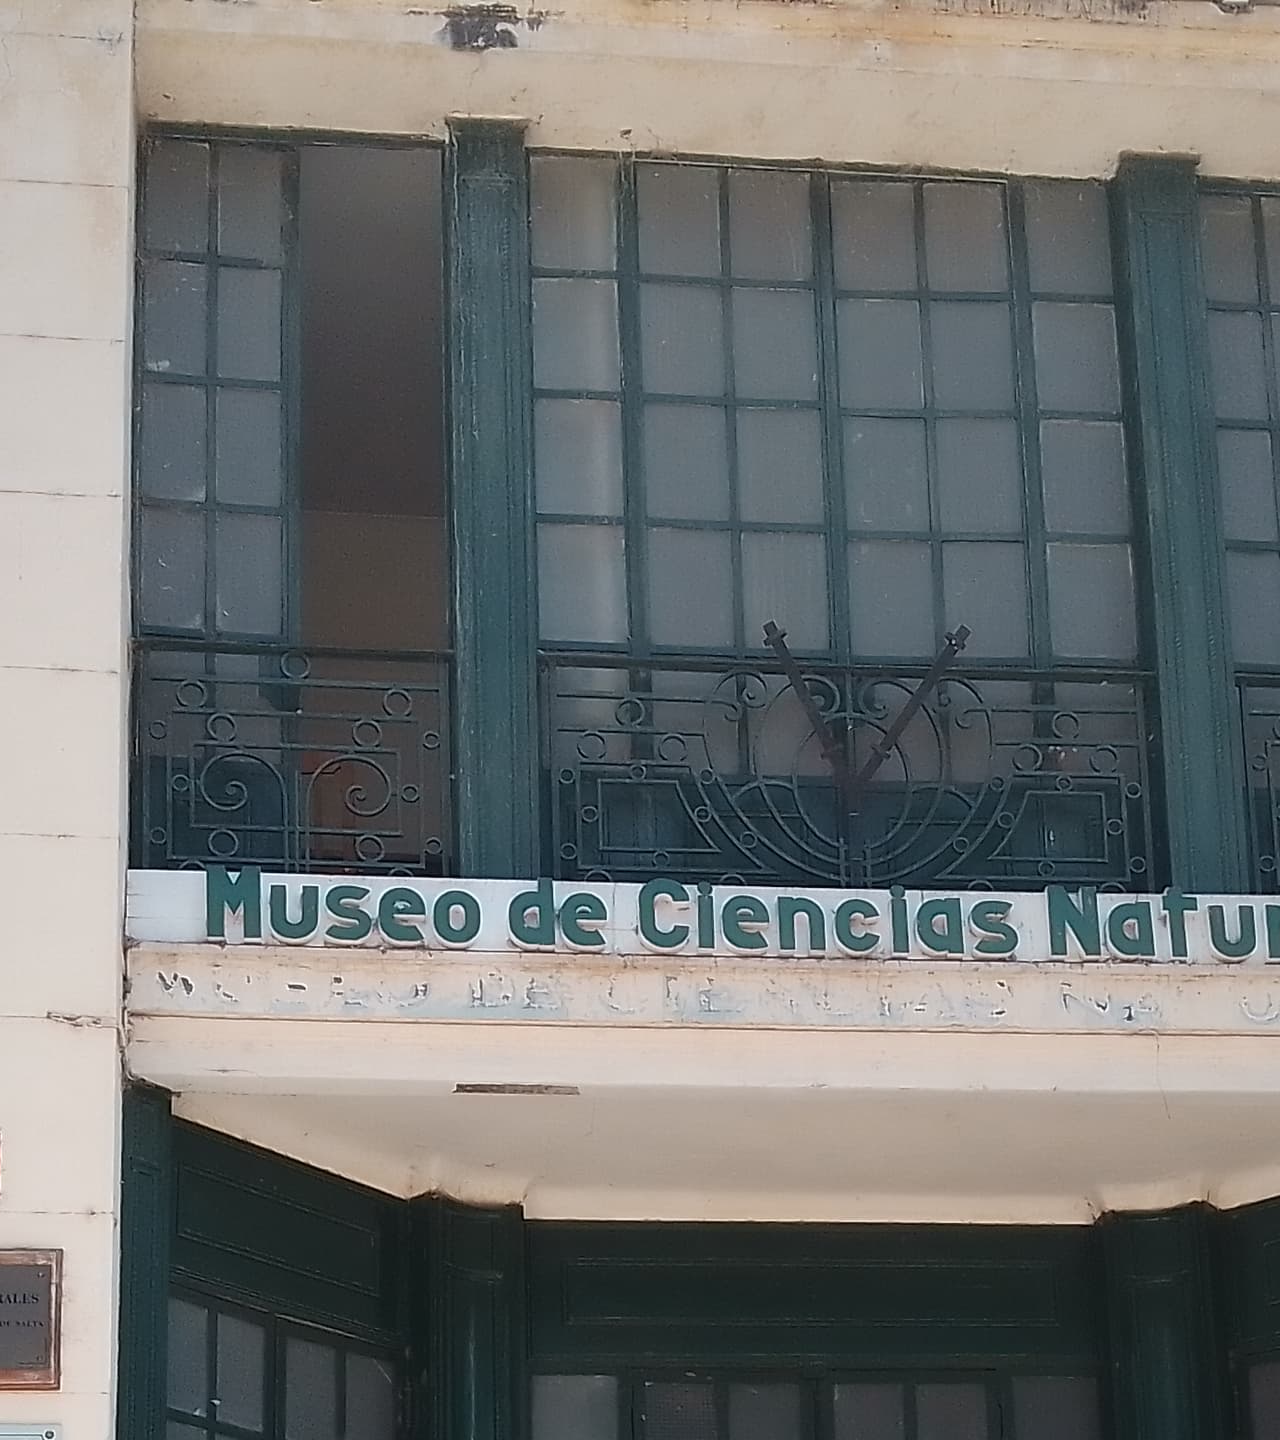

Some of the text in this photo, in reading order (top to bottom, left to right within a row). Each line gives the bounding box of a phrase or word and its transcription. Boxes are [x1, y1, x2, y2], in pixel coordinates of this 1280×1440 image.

[205, 864, 483, 950] Museo
[507, 877, 609, 954] de
[637, 877, 1019, 960] Ciencias
